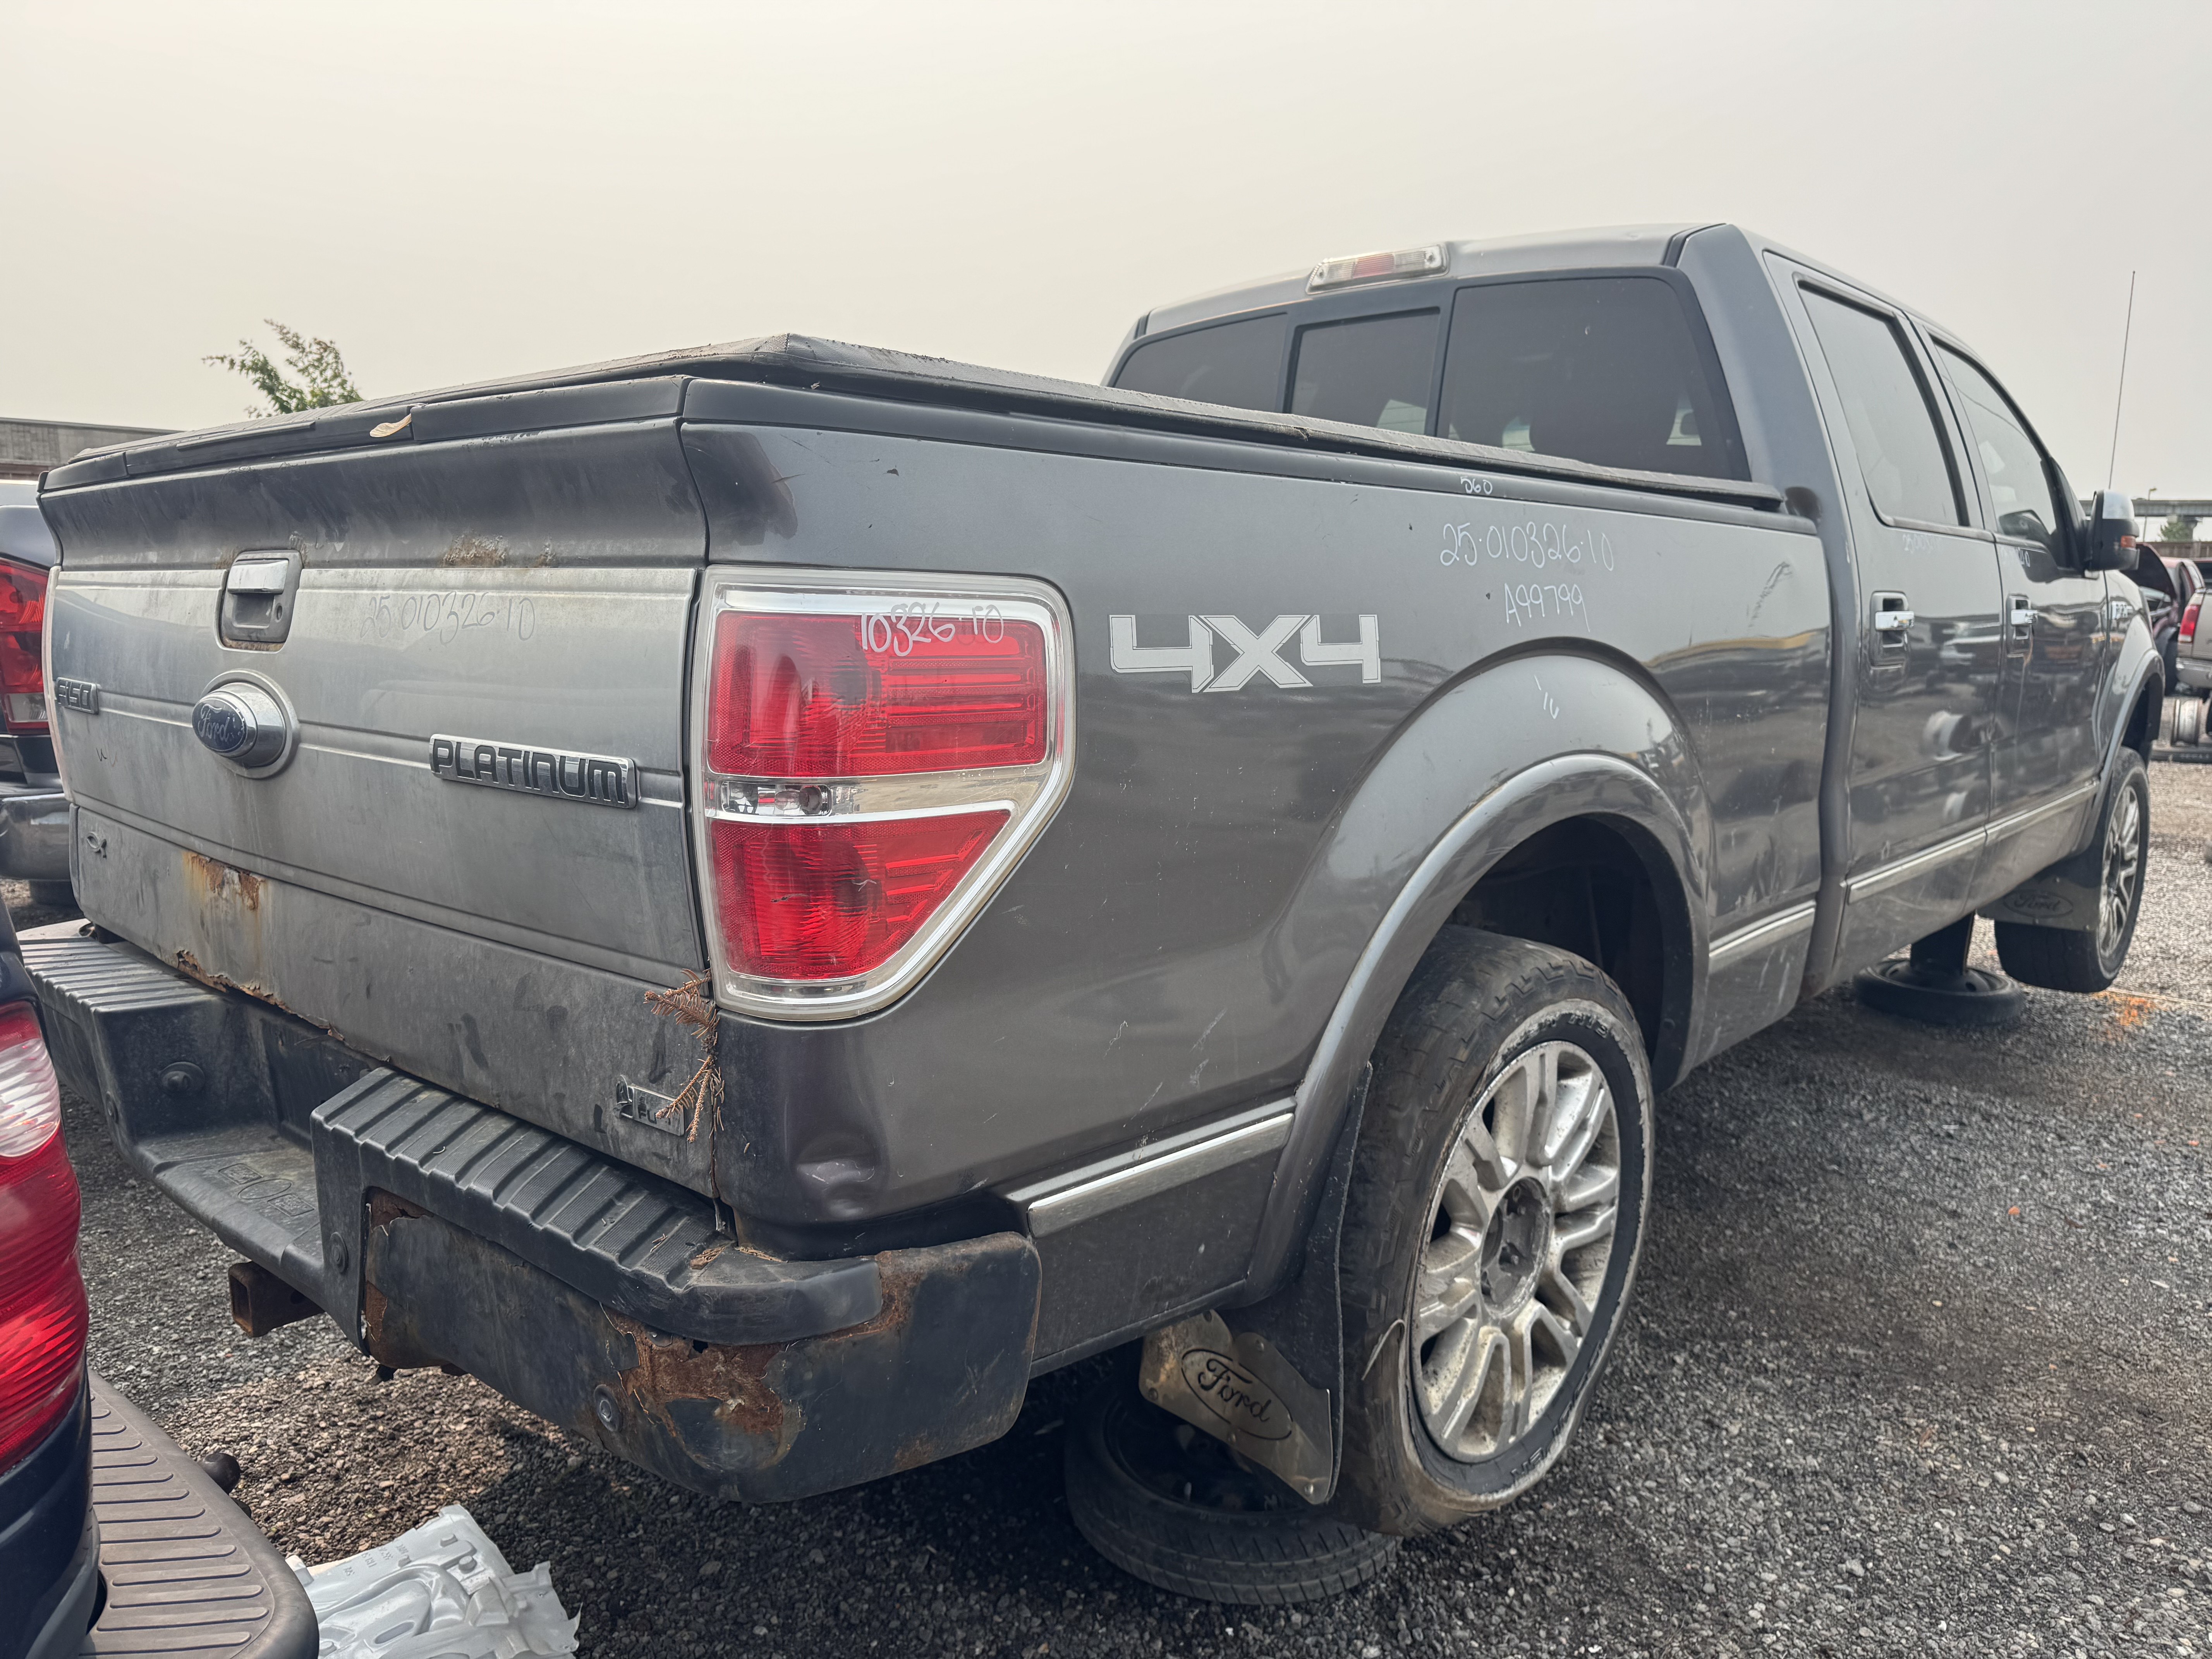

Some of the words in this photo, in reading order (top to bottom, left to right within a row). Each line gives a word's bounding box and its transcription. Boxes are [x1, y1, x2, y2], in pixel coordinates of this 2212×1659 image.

[1504, 583, 1590, 632] A99799
[197, 703, 230, 742] Ford
[433, 738, 625, 804] PLATINUM
[2013, 893, 2061, 912] Ford
[1197, 1358, 1272, 1422] Ford
